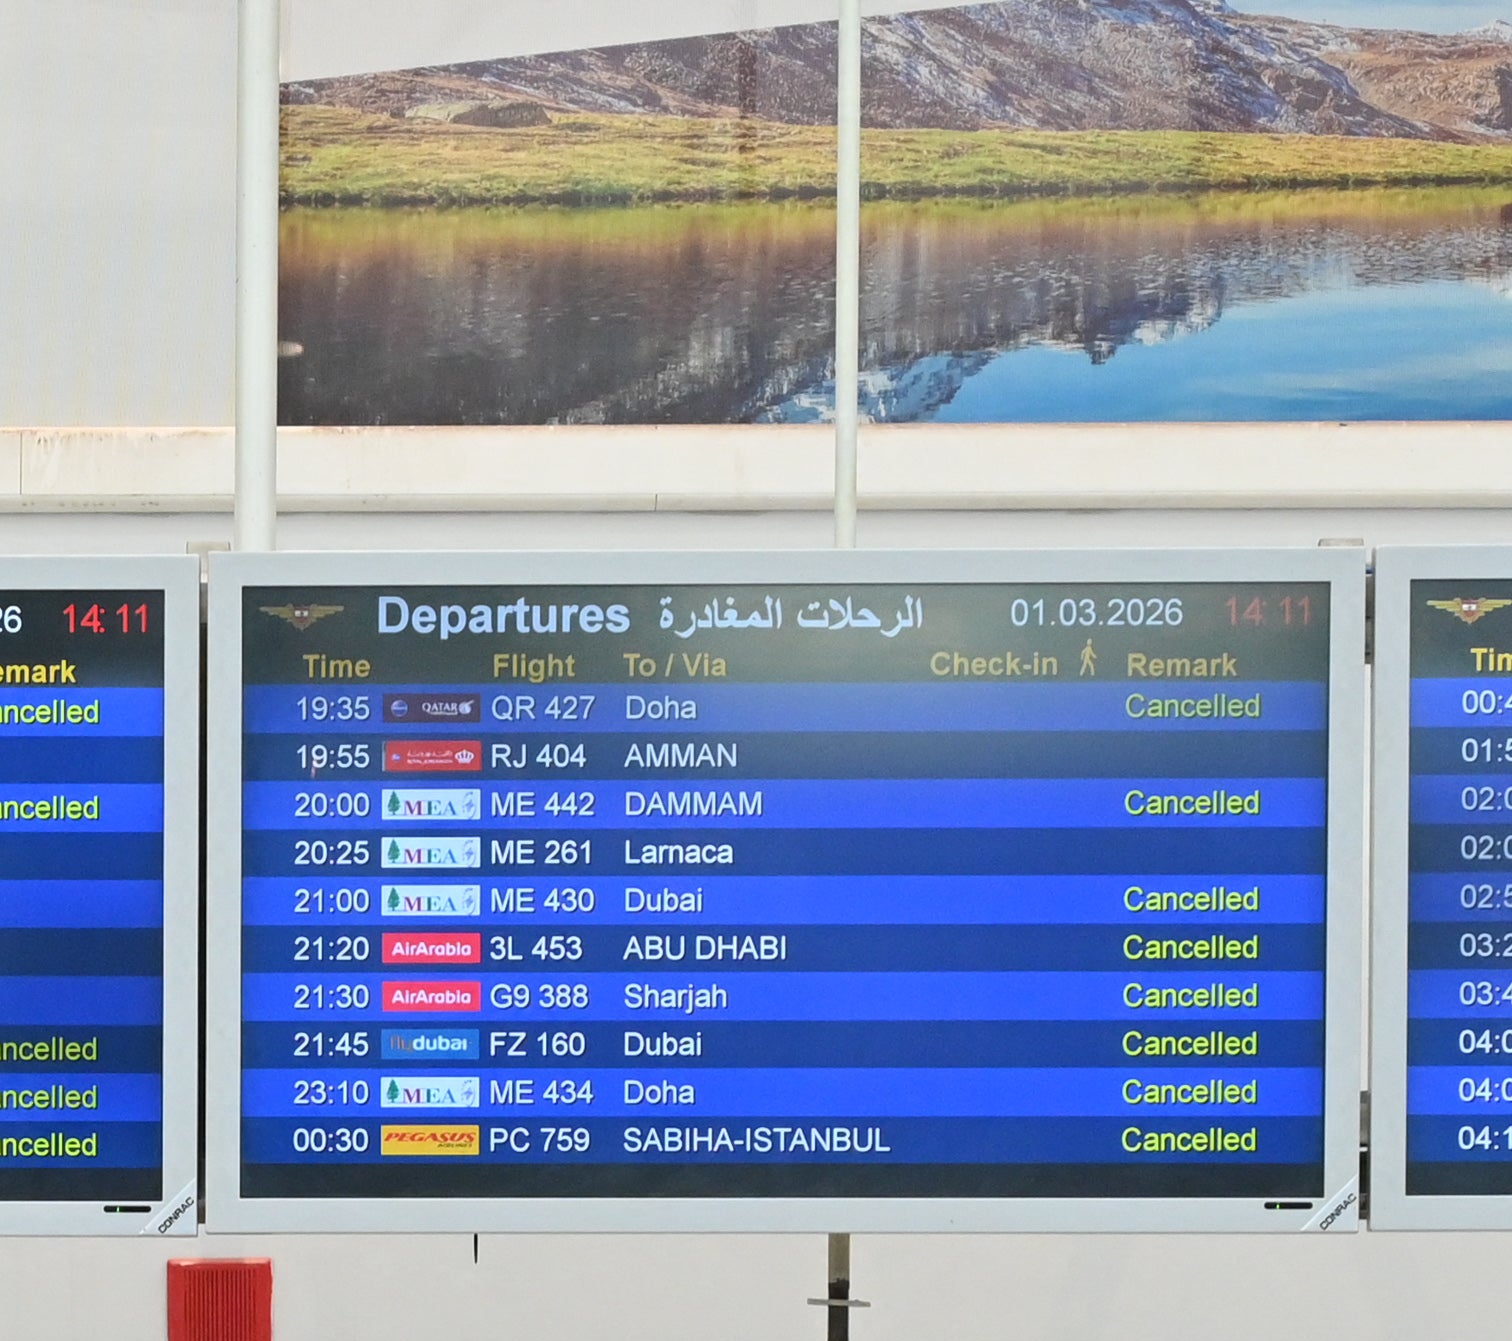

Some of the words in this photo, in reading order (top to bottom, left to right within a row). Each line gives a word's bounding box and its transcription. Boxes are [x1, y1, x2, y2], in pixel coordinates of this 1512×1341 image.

[378, 596, 631, 640] Departures
[659, 594, 783, 639] المغادرة
[796, 594, 923, 638] الرحلات
[1010, 598, 1184, 627] 01.03.2026
[293, 936, 370, 961] 21:20
[489, 935, 524, 961] 3L
[531, 935, 583, 961] 453
[622, 935, 685, 961] ABU
[695, 935, 786, 960] DHABI
[1122, 934, 1258, 960] Cancelled
[391, 941, 472, 956] AirArabia
[391, 989, 472, 1004] AirArabia
[293, 1031, 369, 1057] 21:45
[490, 1031, 527, 1057] FZ
[537, 1031, 586, 1056] 160
[624, 1031, 702, 1057] Dubai
[1122, 1030, 1257, 1056] Cancelled
[293, 1127, 369, 1152] 00:30
[489, 1126, 530, 1153] PC
[540, 1127, 590, 1152] 759
[623, 1126, 891, 1153] SABIHA-ISTANBUL
[1121, 1126, 1256, 1152] Cancelled
[383, 1131, 476, 1143] PEGASUS
